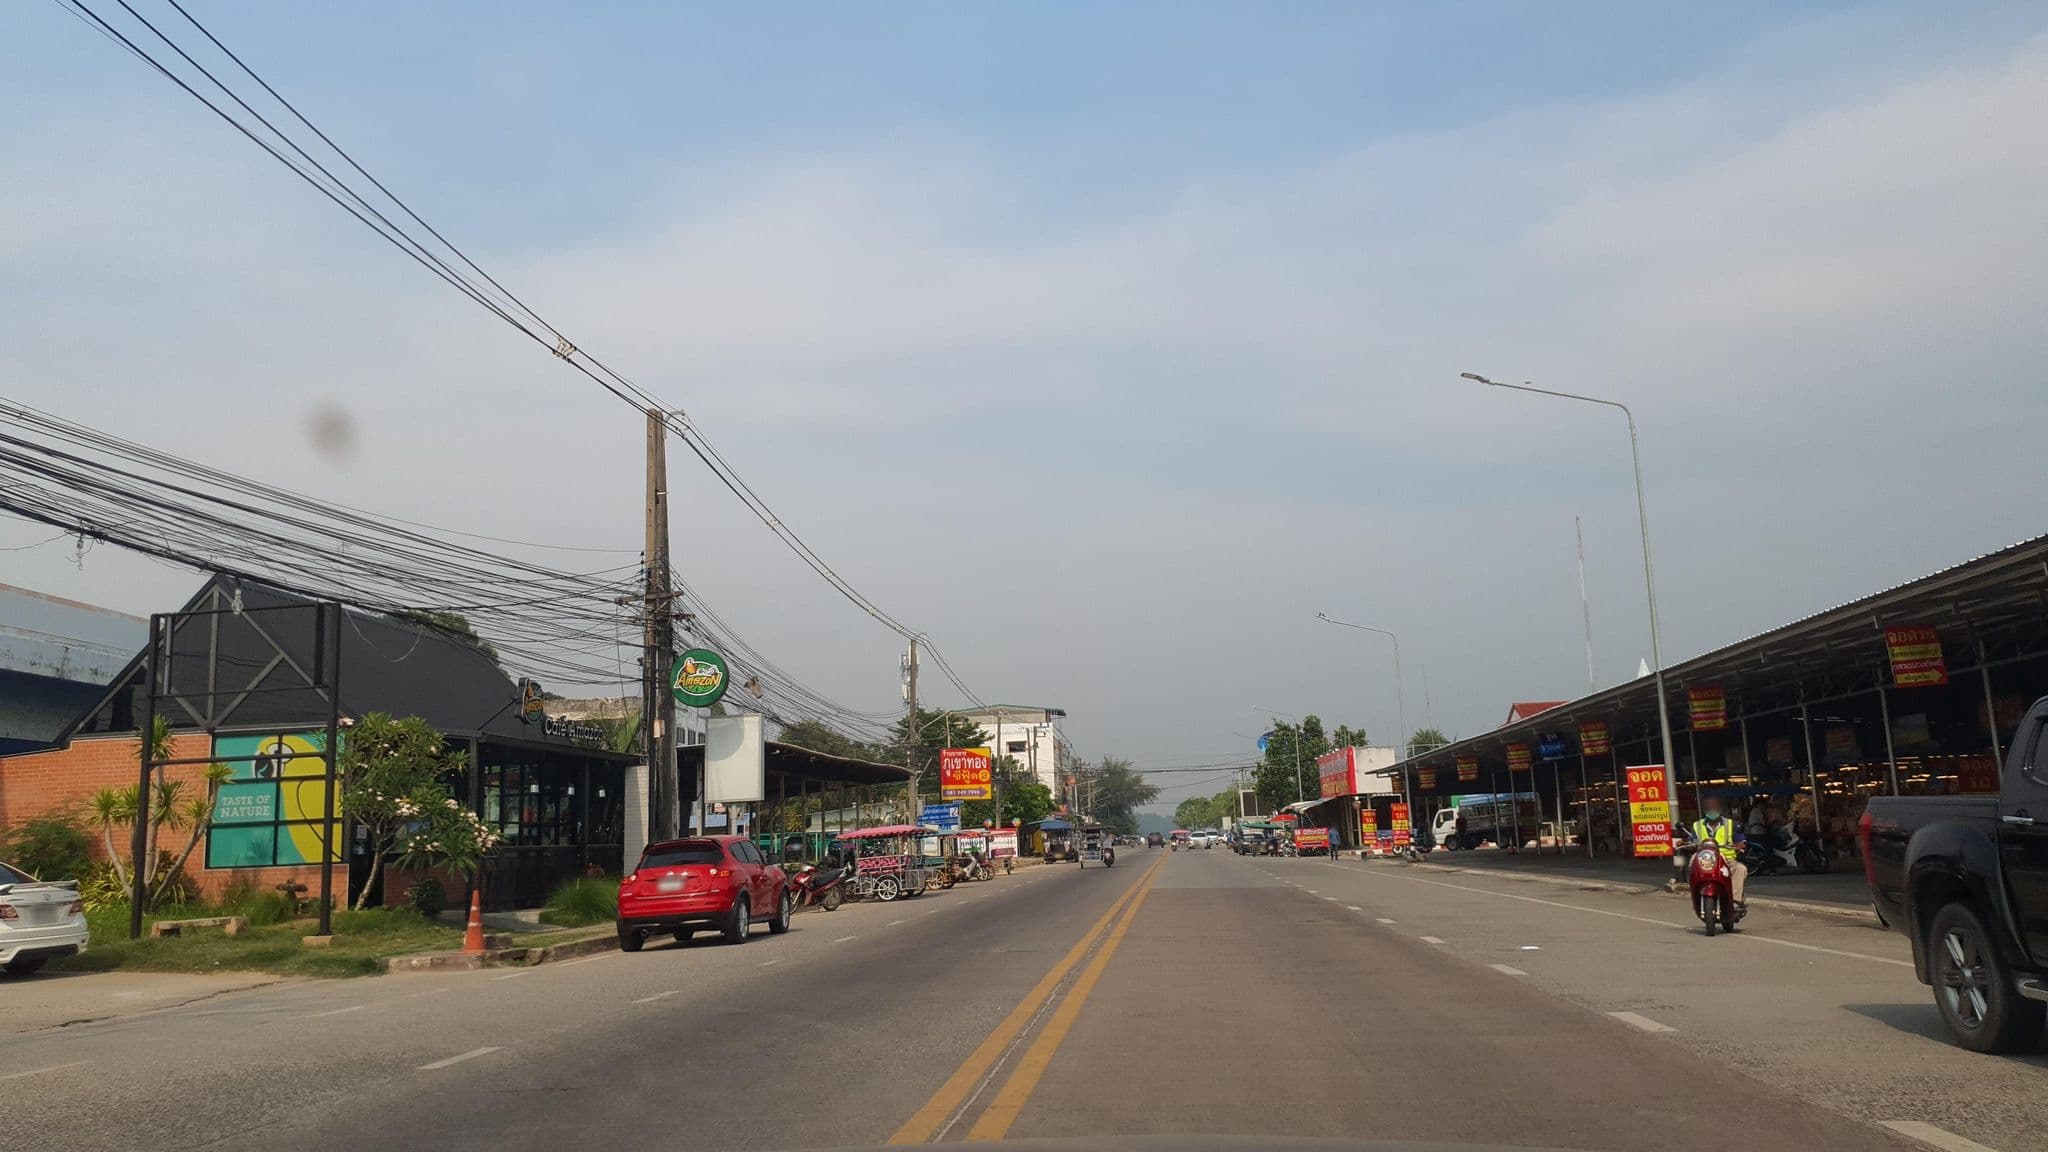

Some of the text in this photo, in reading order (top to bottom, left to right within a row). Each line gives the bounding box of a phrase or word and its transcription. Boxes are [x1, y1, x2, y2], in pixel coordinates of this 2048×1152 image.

[943, 757, 987, 776] ภูเขาทอง
[1630, 771, 1663, 783] จอด
[1637, 787, 1659, 799] รถ
[222, 795, 271, 806] TASTE OF
[220, 806, 271, 818] NATURE
[1638, 823, 1665, 832] ตลาด
[1635, 833, 1669, 842] นวลทิพย์
